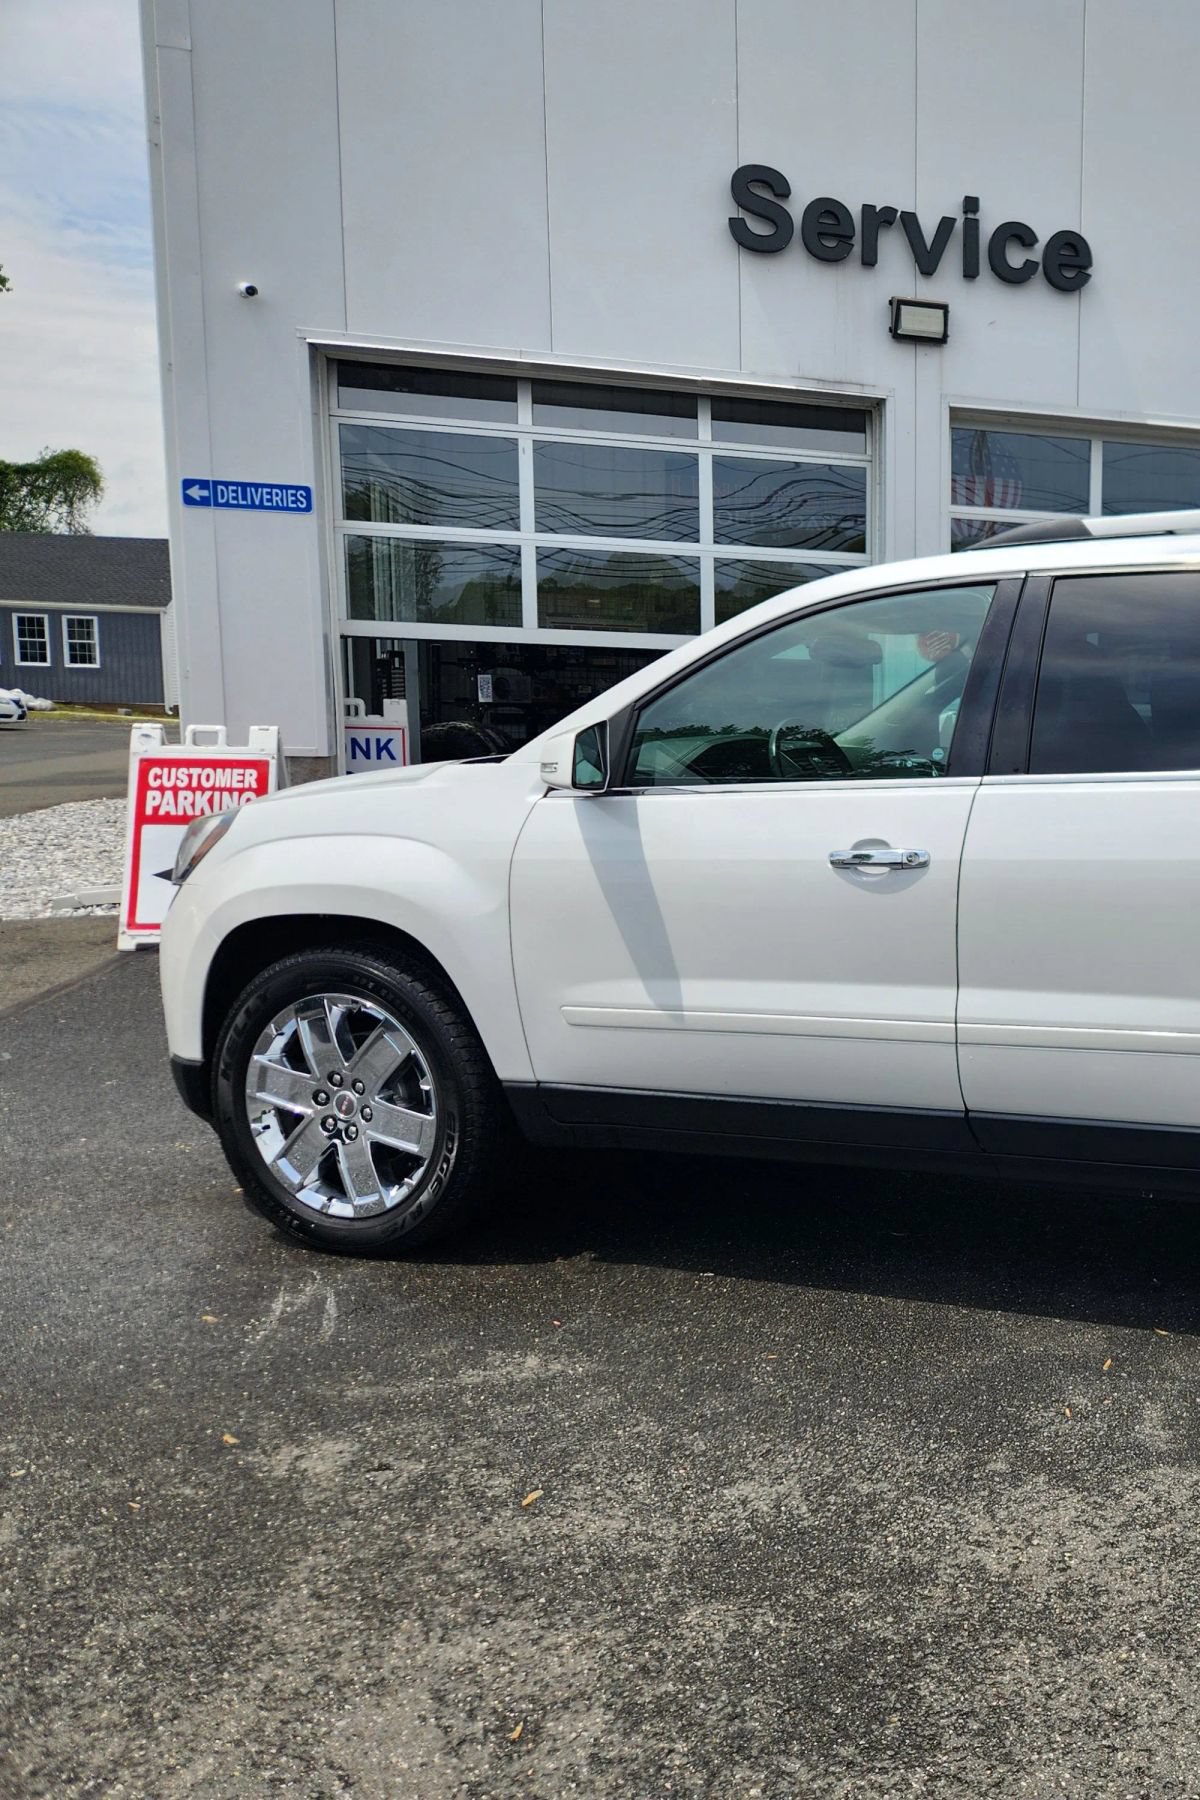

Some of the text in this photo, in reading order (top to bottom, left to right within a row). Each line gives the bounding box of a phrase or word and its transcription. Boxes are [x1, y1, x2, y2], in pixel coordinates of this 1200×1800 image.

[728, 163, 1094, 293] Service
[216, 485, 307, 508] DELIVERIES
[148, 767, 258, 788] CUSTOMER
